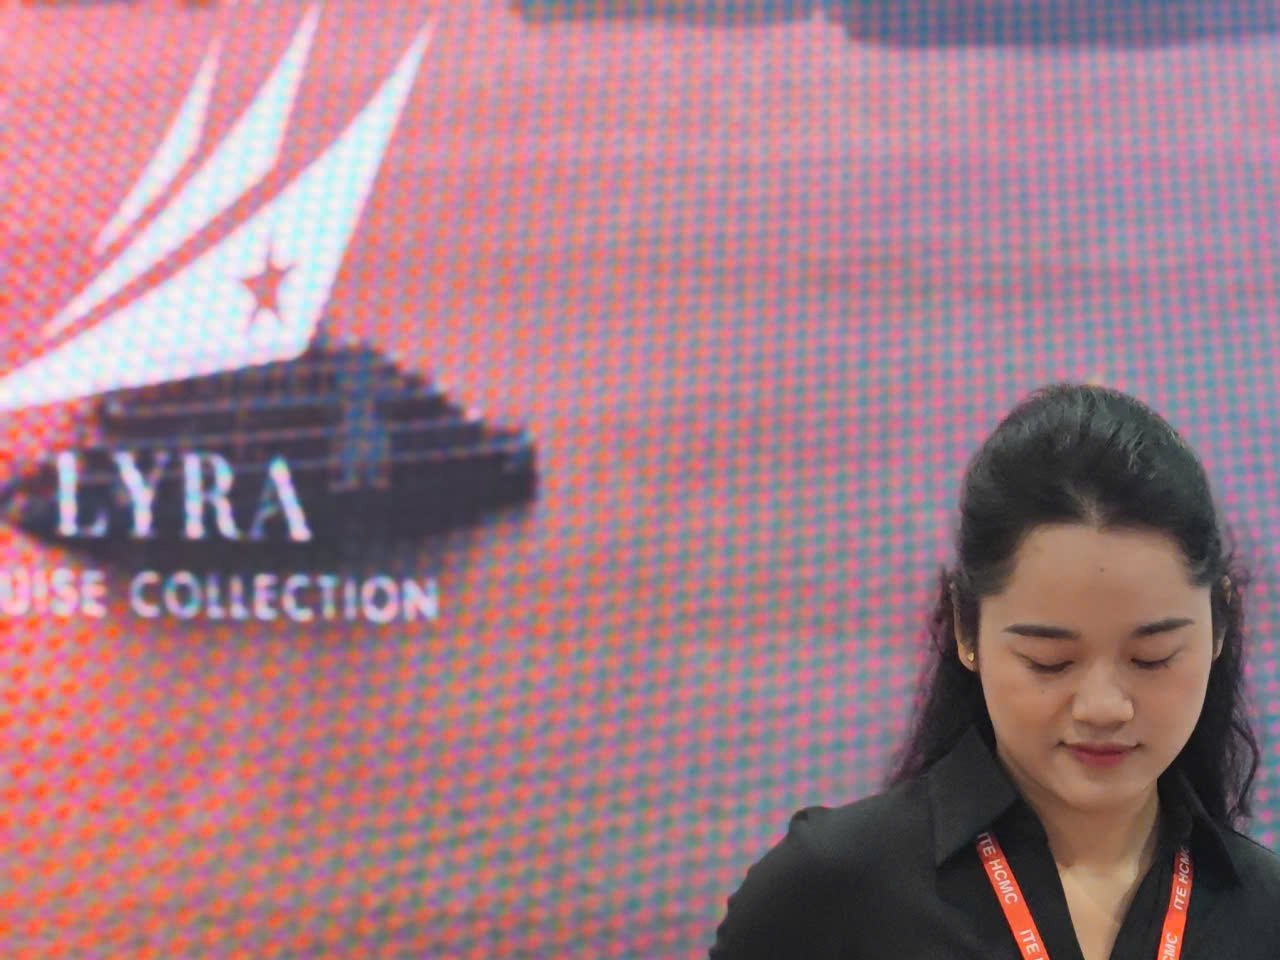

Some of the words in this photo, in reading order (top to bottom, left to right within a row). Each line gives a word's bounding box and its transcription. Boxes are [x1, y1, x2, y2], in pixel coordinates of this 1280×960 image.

[55, 450, 312, 542] LYRA
[130, 570, 440, 623] COLLECTION
[977, 832, 996, 857] ITE
[989, 859, 1019, 905] HCMC
[1173, 886, 1188, 911] ITE
[1019, 929, 1041, 955] ITE
